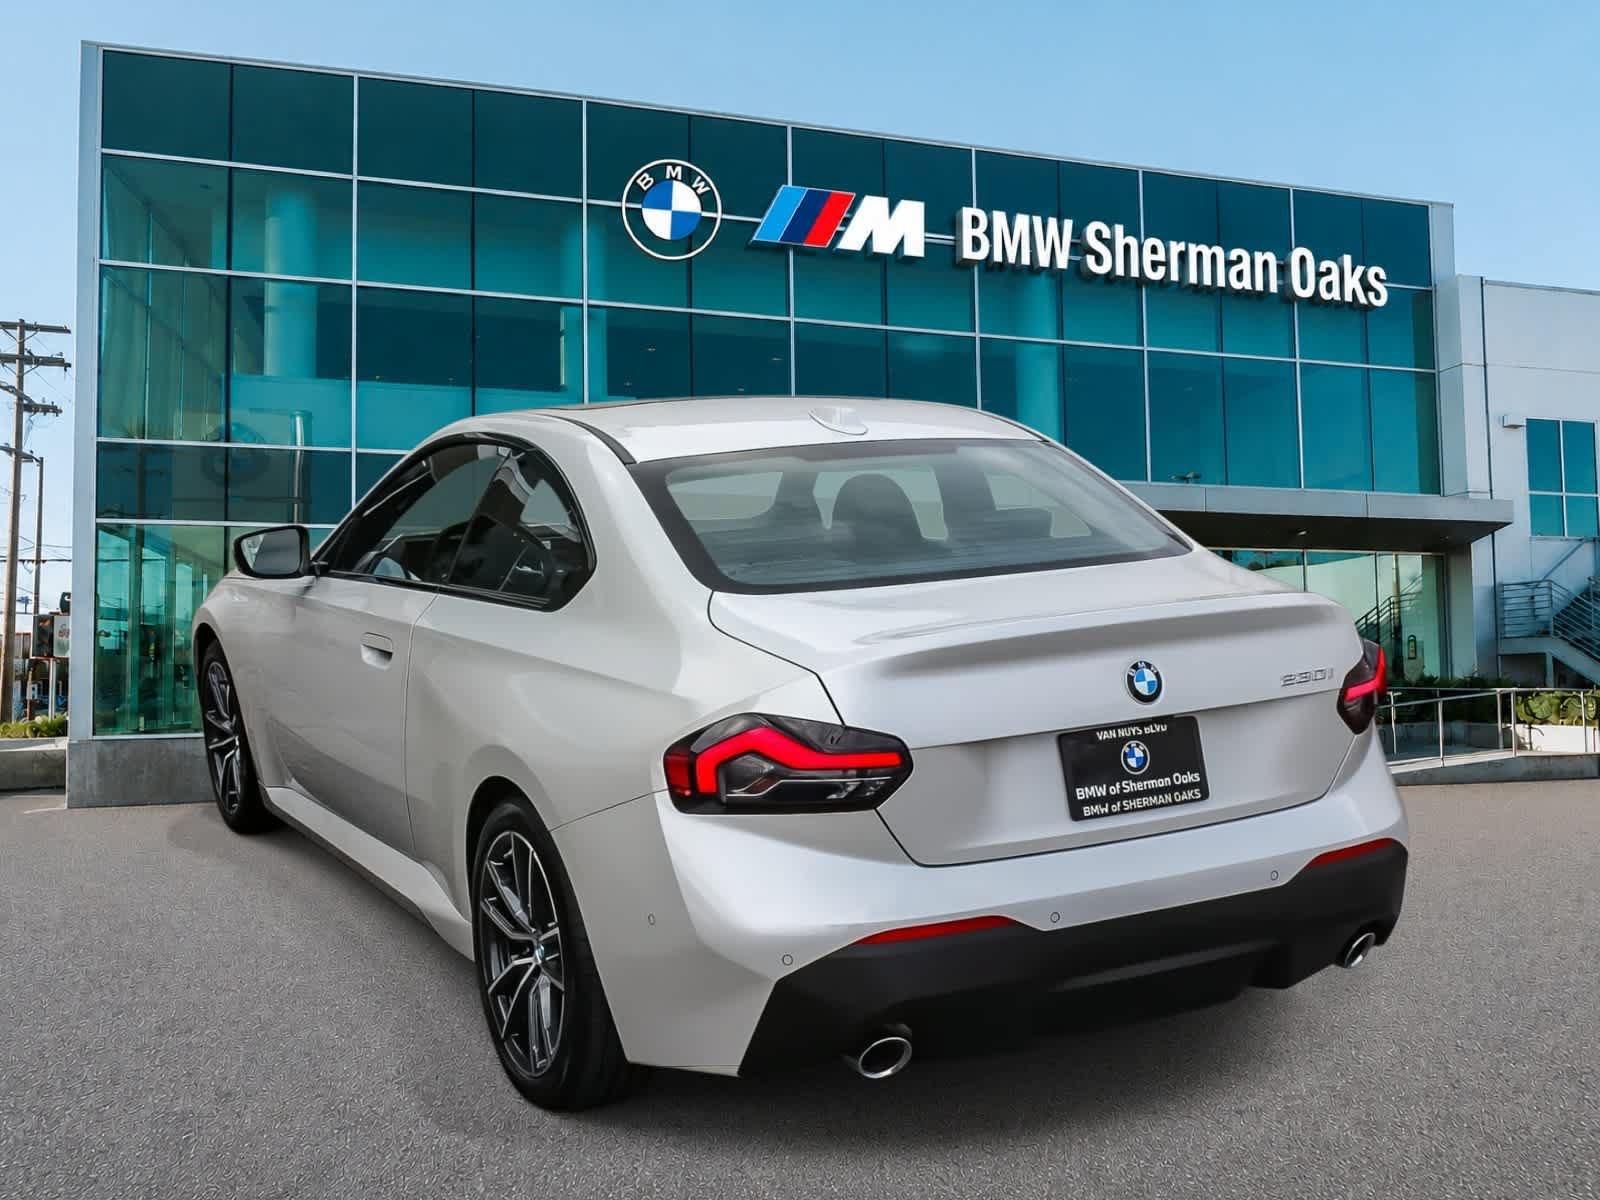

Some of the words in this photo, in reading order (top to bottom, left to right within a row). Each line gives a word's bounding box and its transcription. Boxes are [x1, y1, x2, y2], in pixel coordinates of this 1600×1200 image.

[637, 164, 711, 191] BMW
[961, 206, 1073, 270] BMW
[1085, 220, 1278, 293] Sherman
[1290, 246, 1388, 308] Oaks
[1096, 728, 1117, 741] VAN
[1117, 726, 1143, 739] NUYS
[1075, 783, 1107, 800] BMW
[1109, 781, 1121, 795] of
[1121, 777, 1172, 794] Sherman
[1172, 771, 1201, 785] Oaks
[1082, 802, 1109, 817] BMW
[1111, 801, 1121, 813] of
[1122, 793, 1172, 811] SHERMAN
[1173, 788, 1202, 802] OAKS
